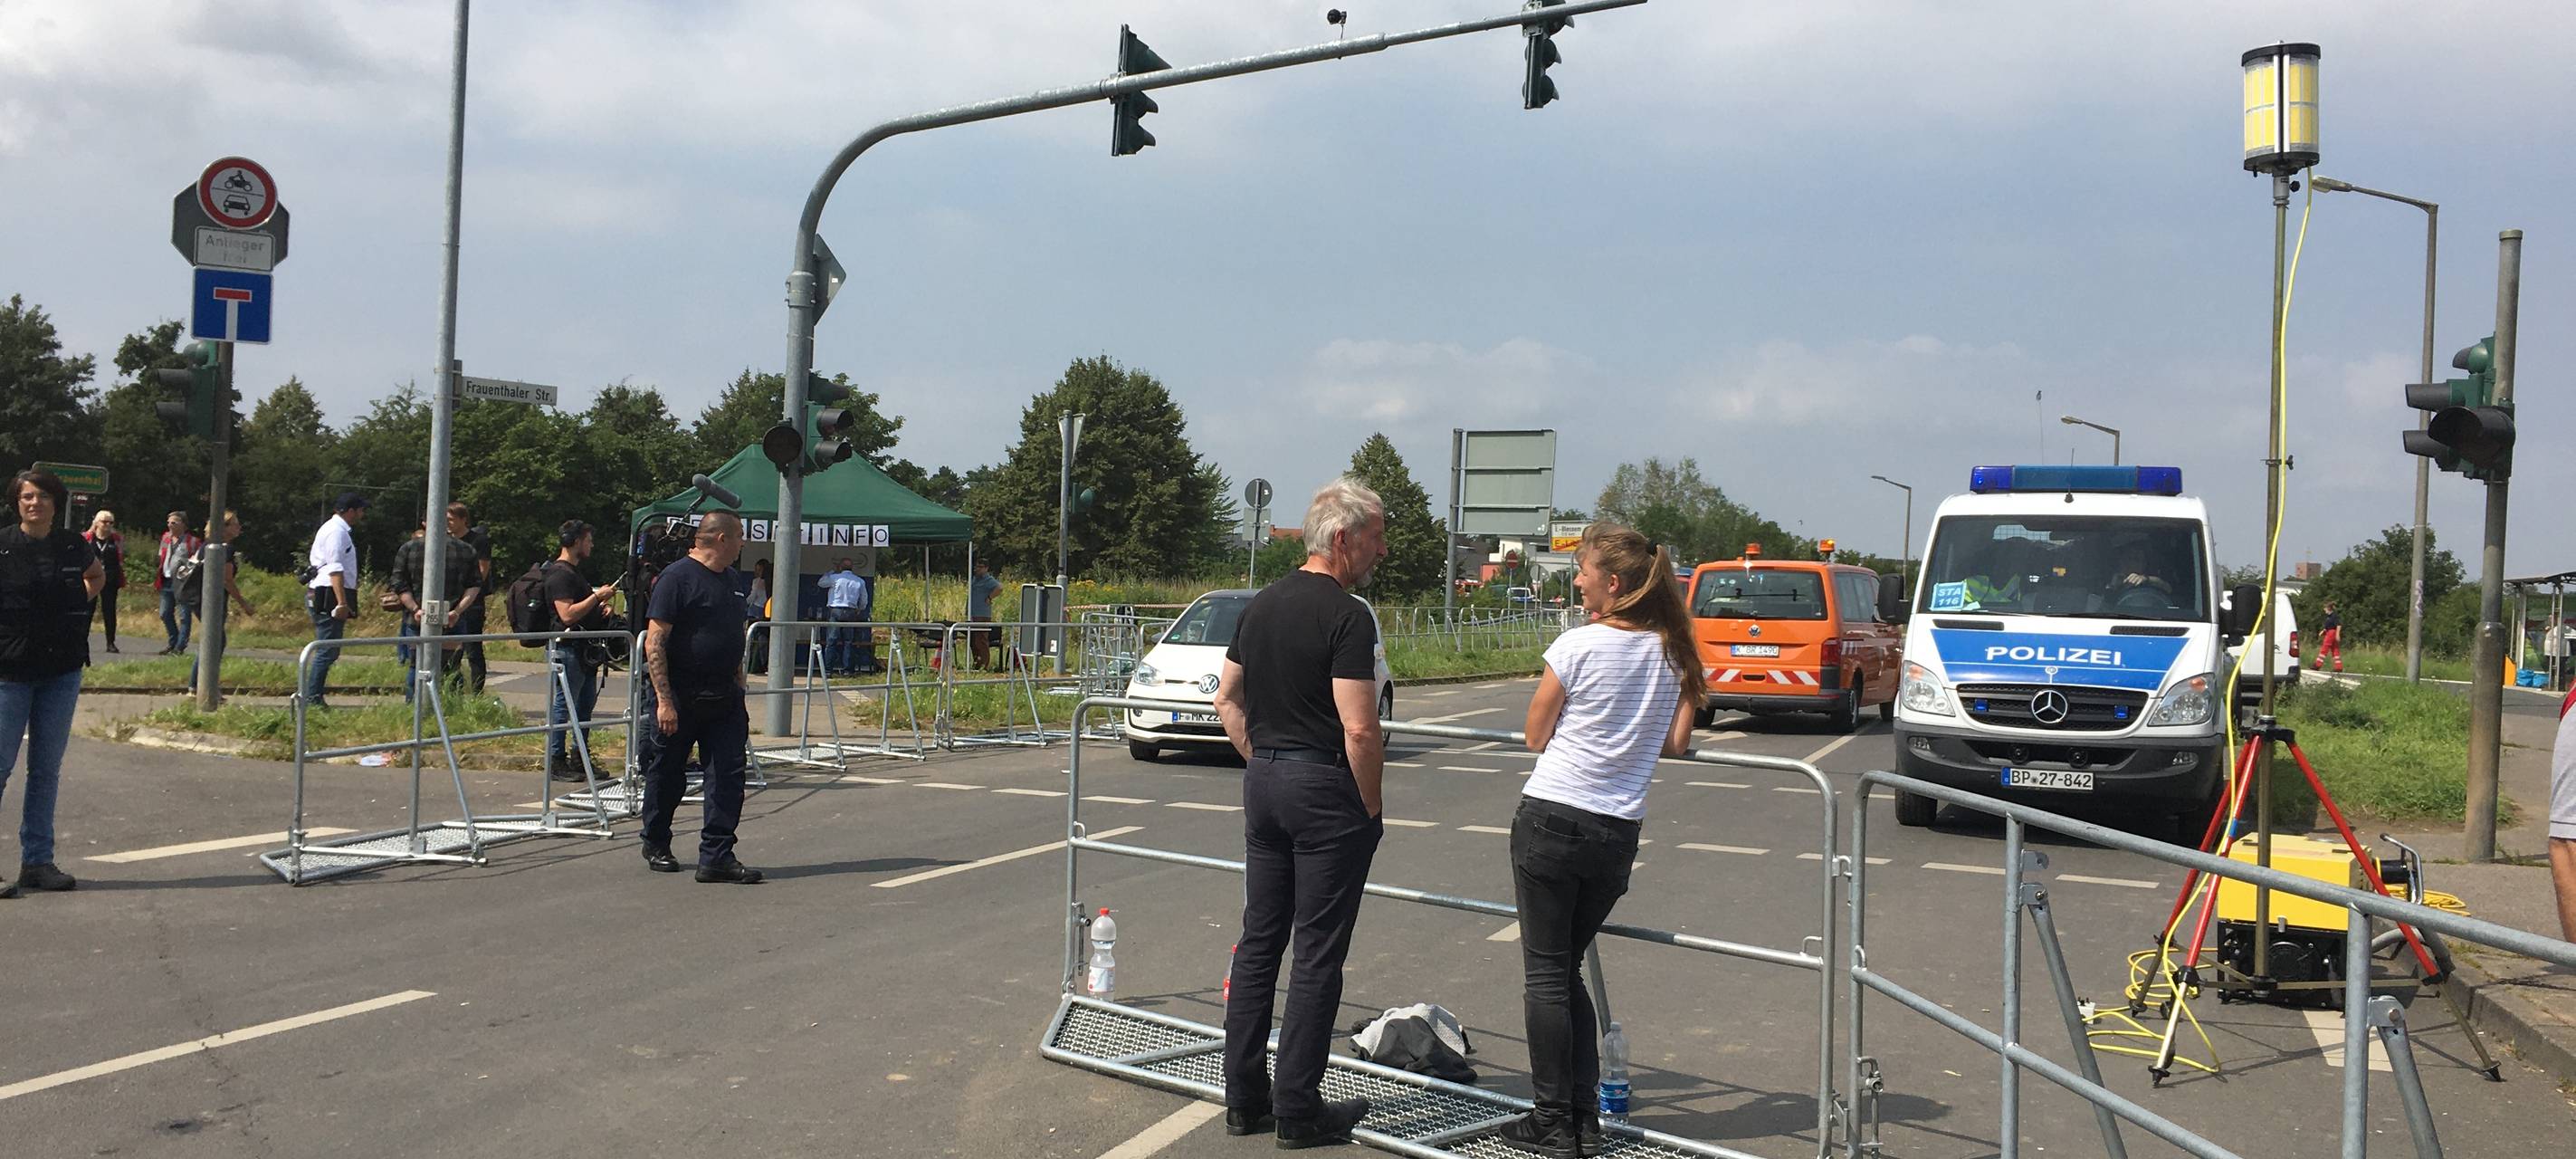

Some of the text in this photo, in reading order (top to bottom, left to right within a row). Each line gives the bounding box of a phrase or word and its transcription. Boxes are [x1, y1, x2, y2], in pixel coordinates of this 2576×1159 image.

[466, 380, 553, 402] Frauenthaler Str.
[1937, 588, 1961, 597] STA
[1939, 598, 1960, 606] 116
[1986, 646, 2122, 666] POLIZEI
